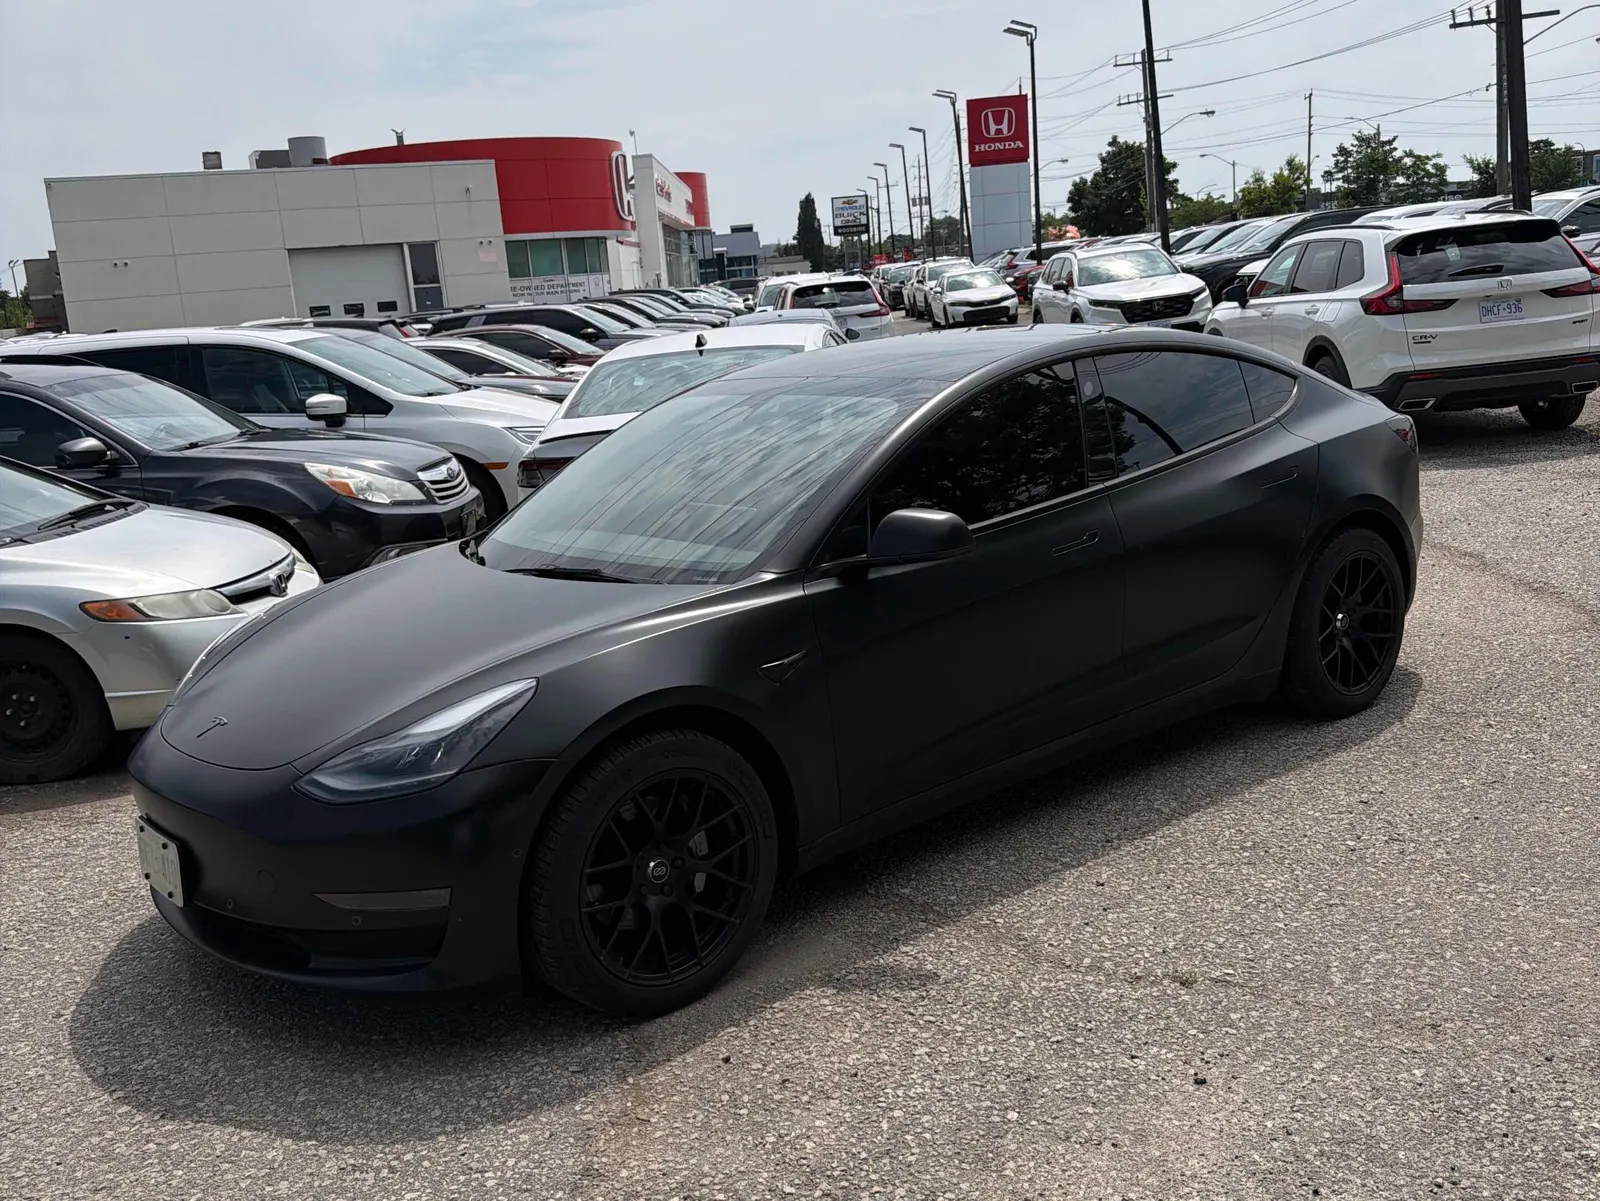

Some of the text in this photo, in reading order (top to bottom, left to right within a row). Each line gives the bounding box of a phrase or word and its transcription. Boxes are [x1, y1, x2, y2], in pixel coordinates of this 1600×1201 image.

[974, 141, 1024, 152] HONDA
[835, 211, 867, 219] BUICK
[1506, 302, 1523, 314] 936
